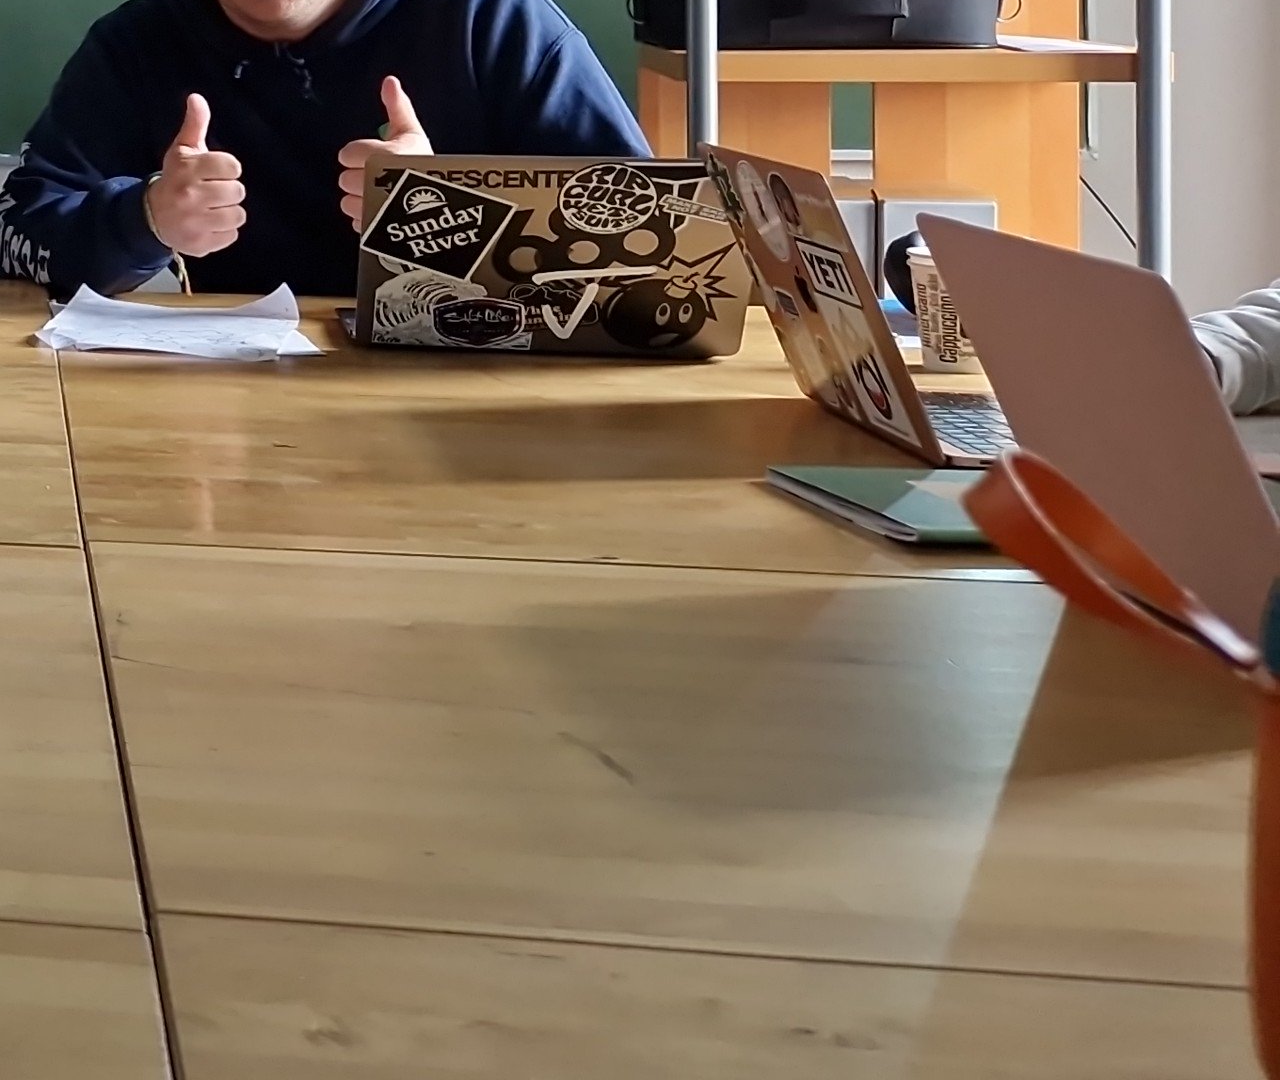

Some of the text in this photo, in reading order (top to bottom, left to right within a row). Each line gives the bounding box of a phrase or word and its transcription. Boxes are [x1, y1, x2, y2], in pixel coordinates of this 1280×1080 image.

[386, 204, 484, 242] Sunday
[407, 228, 480, 258] River
[802, 250, 854, 297] YETI
